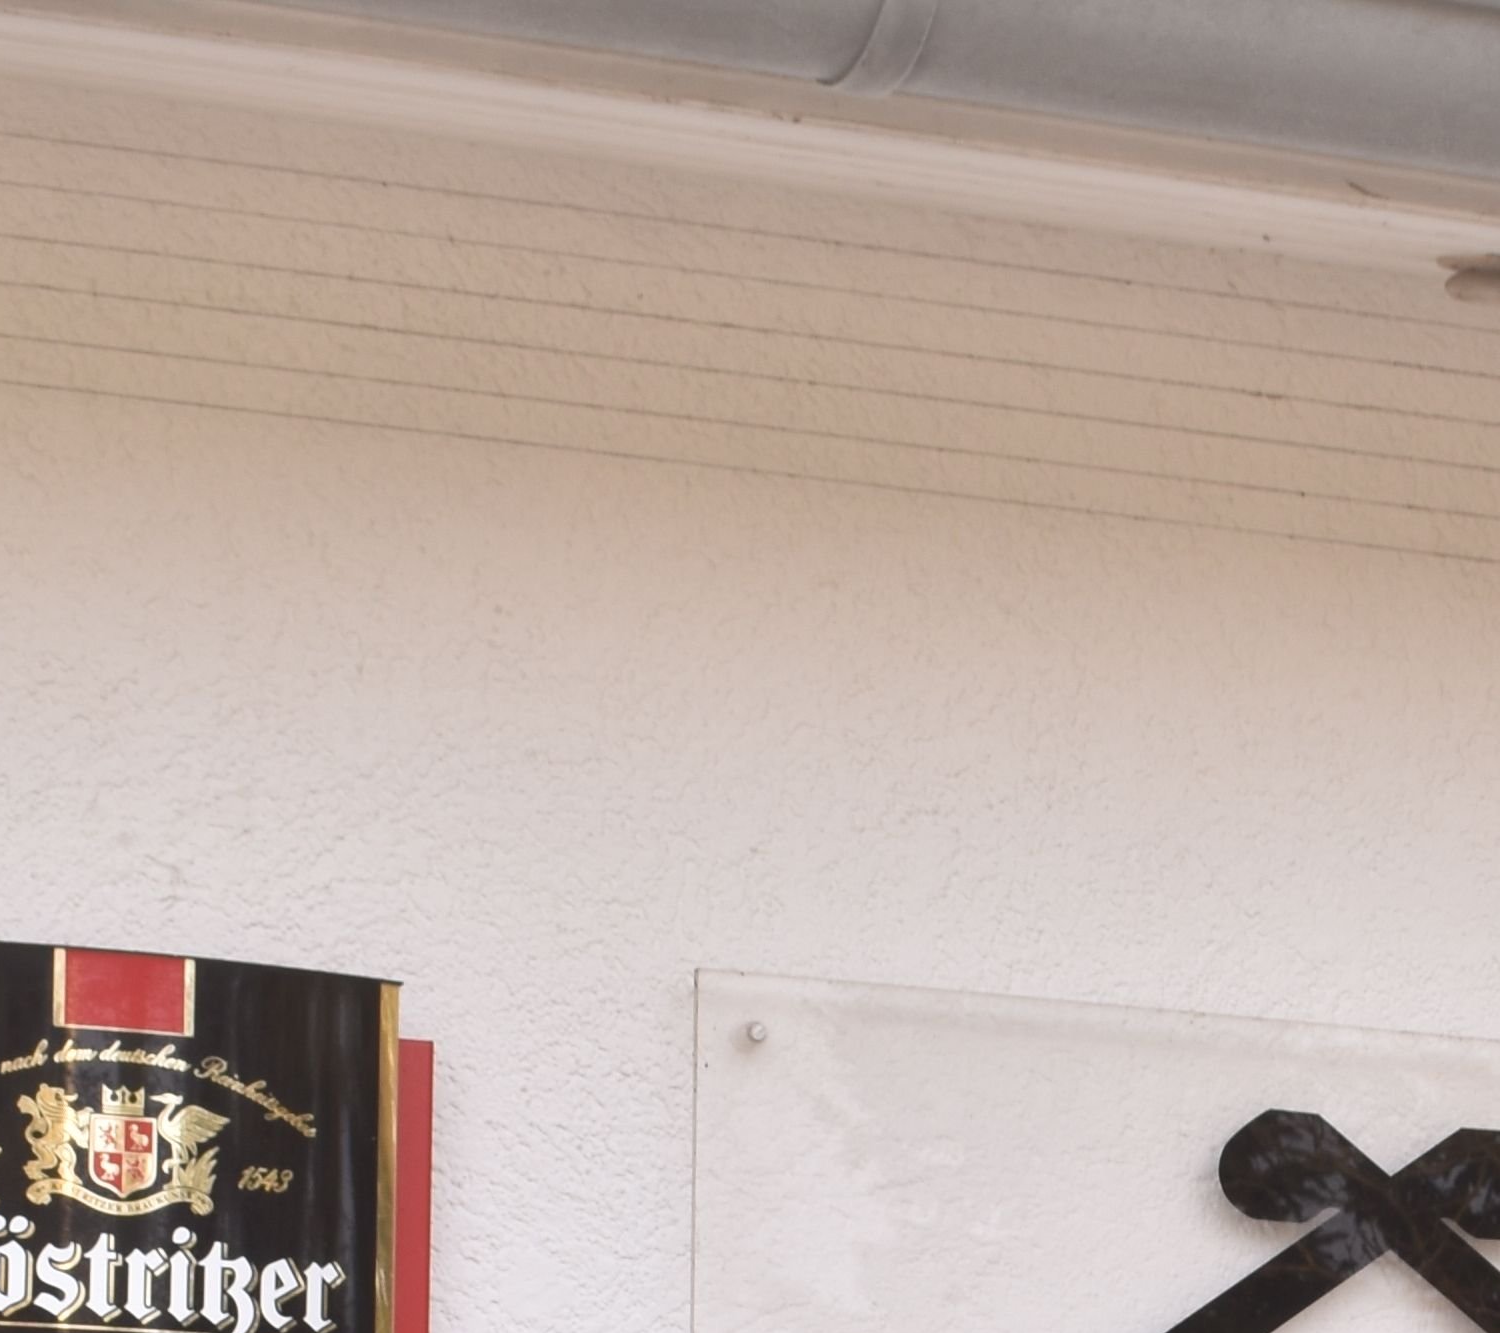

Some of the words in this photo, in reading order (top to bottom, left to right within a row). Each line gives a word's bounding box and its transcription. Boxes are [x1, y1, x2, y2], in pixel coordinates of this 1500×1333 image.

[0, 1039, 49, 1074] nach
[53, 1038, 98, 1063] dem
[99, 1040, 192, 1072] deutschen
[238, 1165, 294, 1192] 1543
